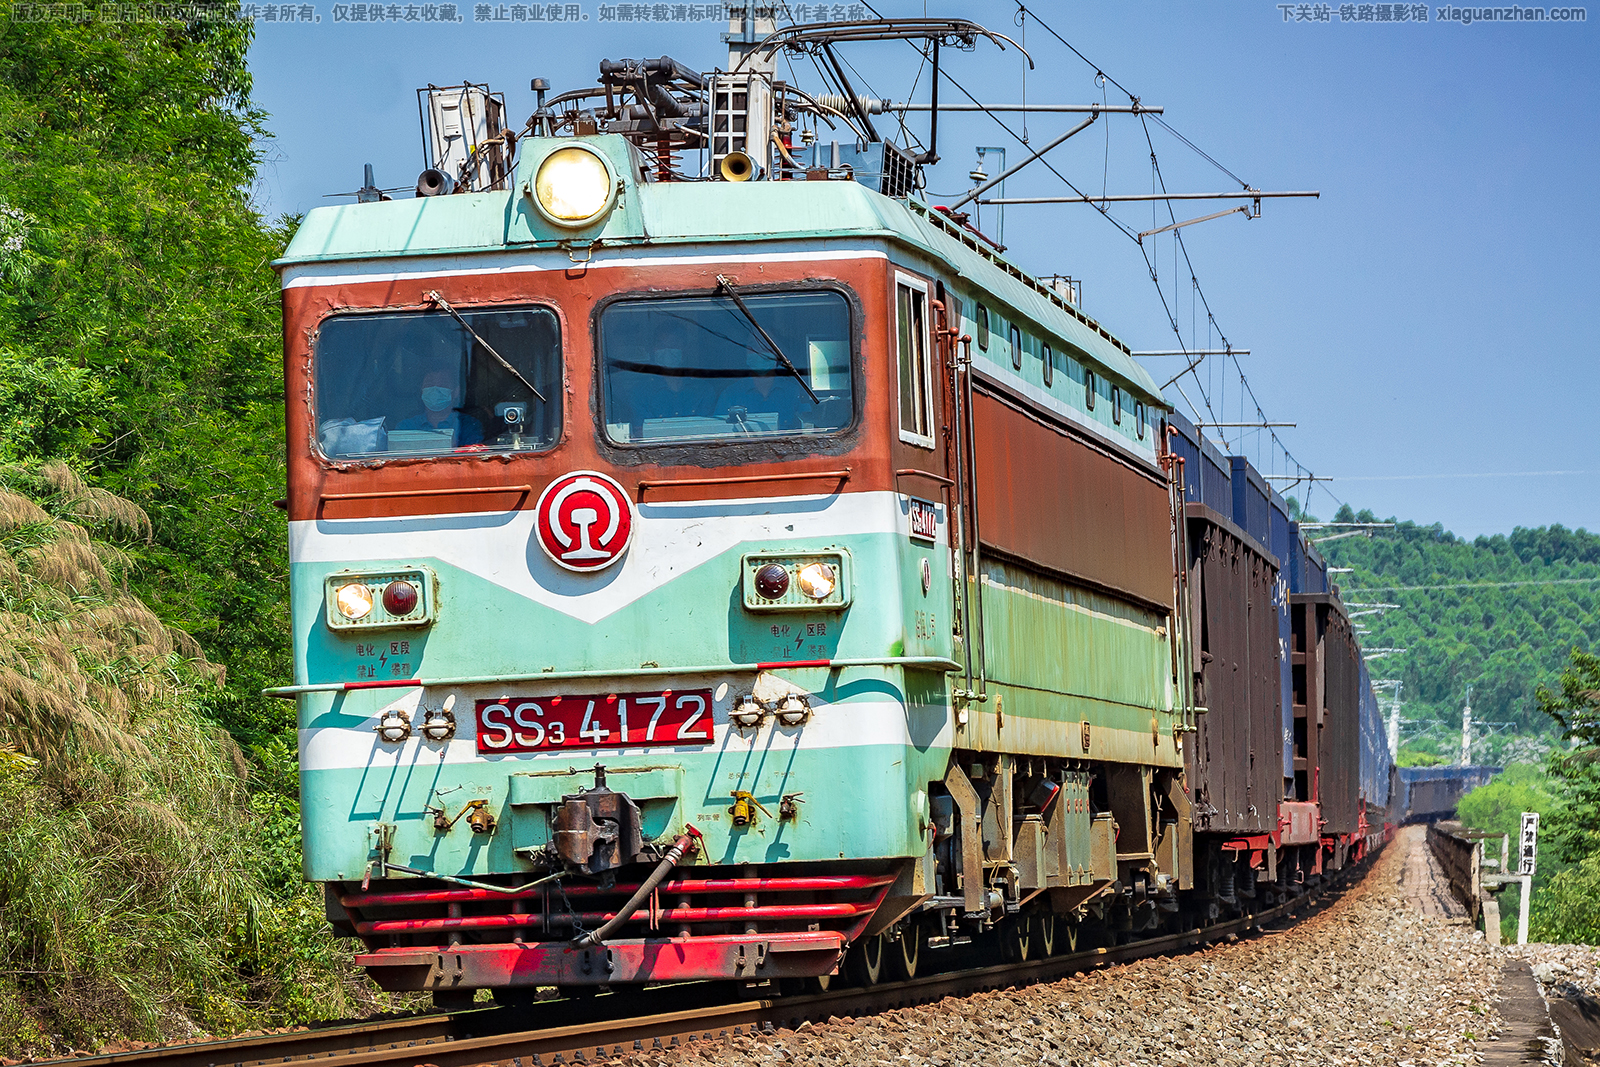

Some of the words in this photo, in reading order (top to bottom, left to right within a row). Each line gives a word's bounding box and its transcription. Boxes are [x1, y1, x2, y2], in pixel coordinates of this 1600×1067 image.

[770, 624, 791, 638] 电化
[806, 623, 827, 637] 区段
[356, 643, 375, 657] 电化
[390, 641, 410, 655] 区段
[481, 703, 565, 748] SS3
[579, 695, 707, 743] 4172
